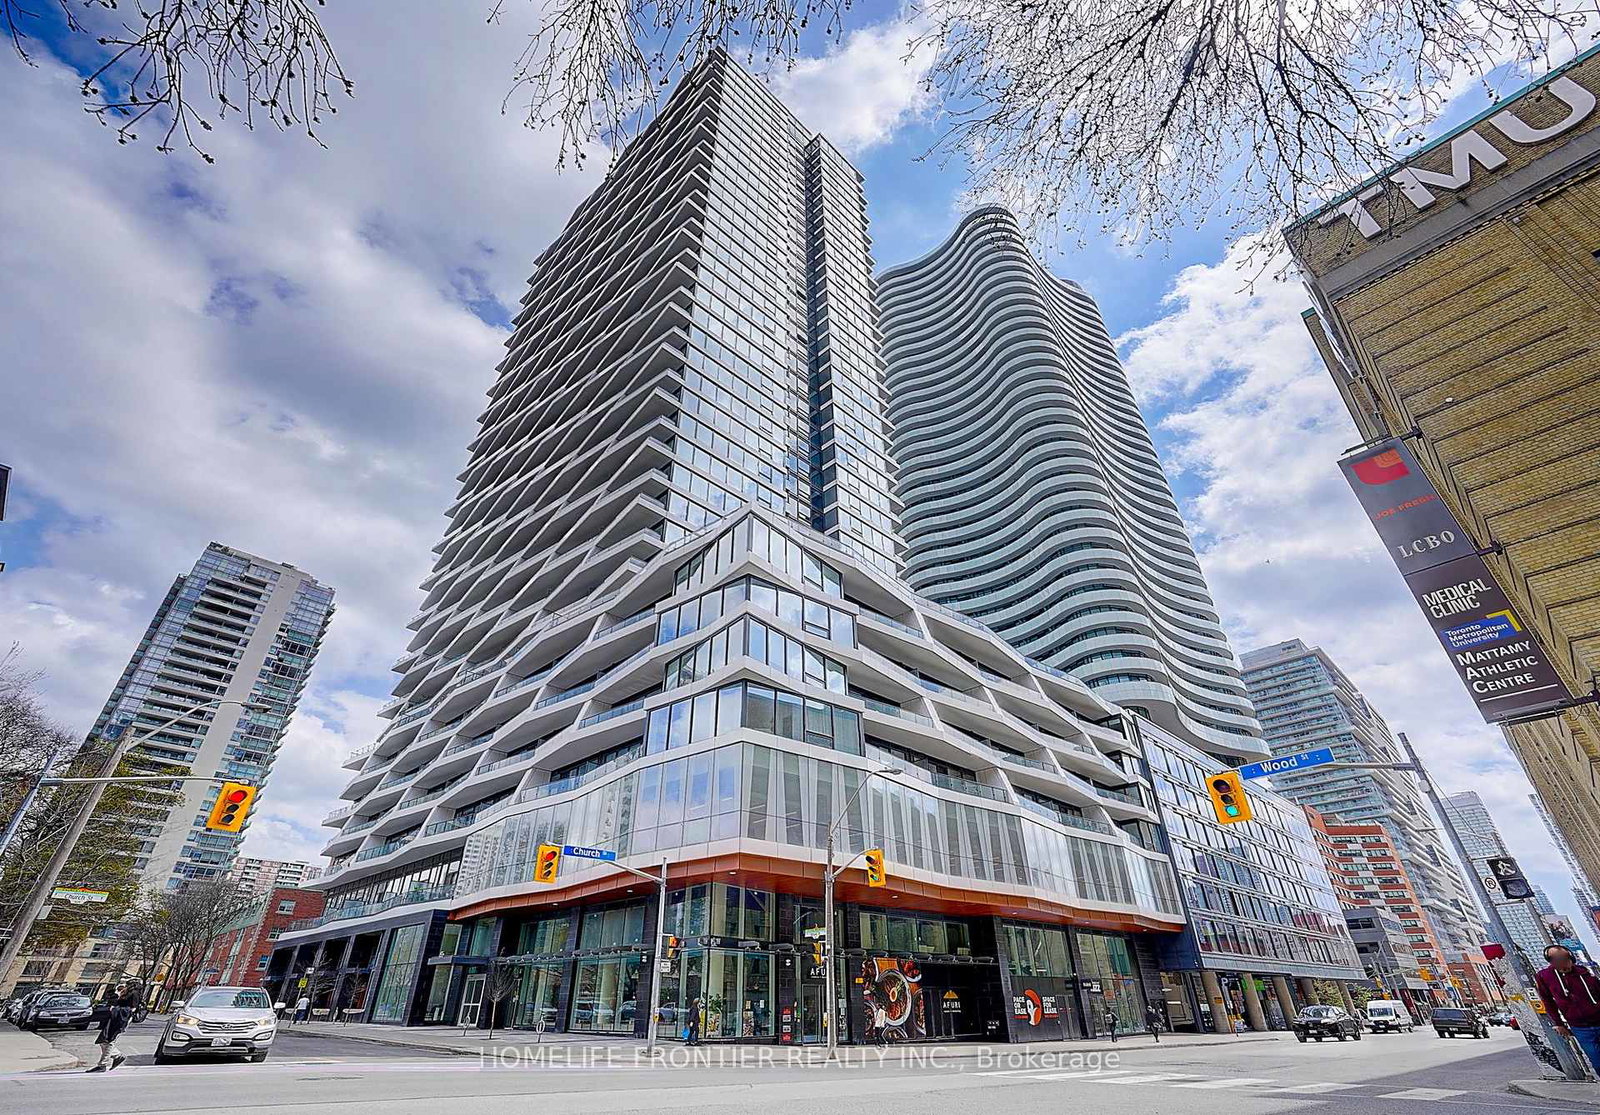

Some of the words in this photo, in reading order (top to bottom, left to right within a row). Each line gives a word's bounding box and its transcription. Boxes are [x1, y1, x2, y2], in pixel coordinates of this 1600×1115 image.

[1317, 76, 1596, 240] TMU
[1397, 530, 1455, 558] LCBO
[1422, 578, 1492, 607] MEDICAL
[1430, 595, 1480, 619] CLINIC
[1445, 624, 1481, 637] Toronto
[1449, 623, 1508, 642] Metropolitan
[1452, 632, 1499, 648] University
[1456, 641, 1531, 666] MATTAMY
[1466, 656, 1538, 680] ATHLETIC
[1472, 673, 1536, 693] CENTRE
[1260, 757, 1298, 773] Wood
[1300, 753, 1309, 761] St
[573, 847, 600, 857] Church
